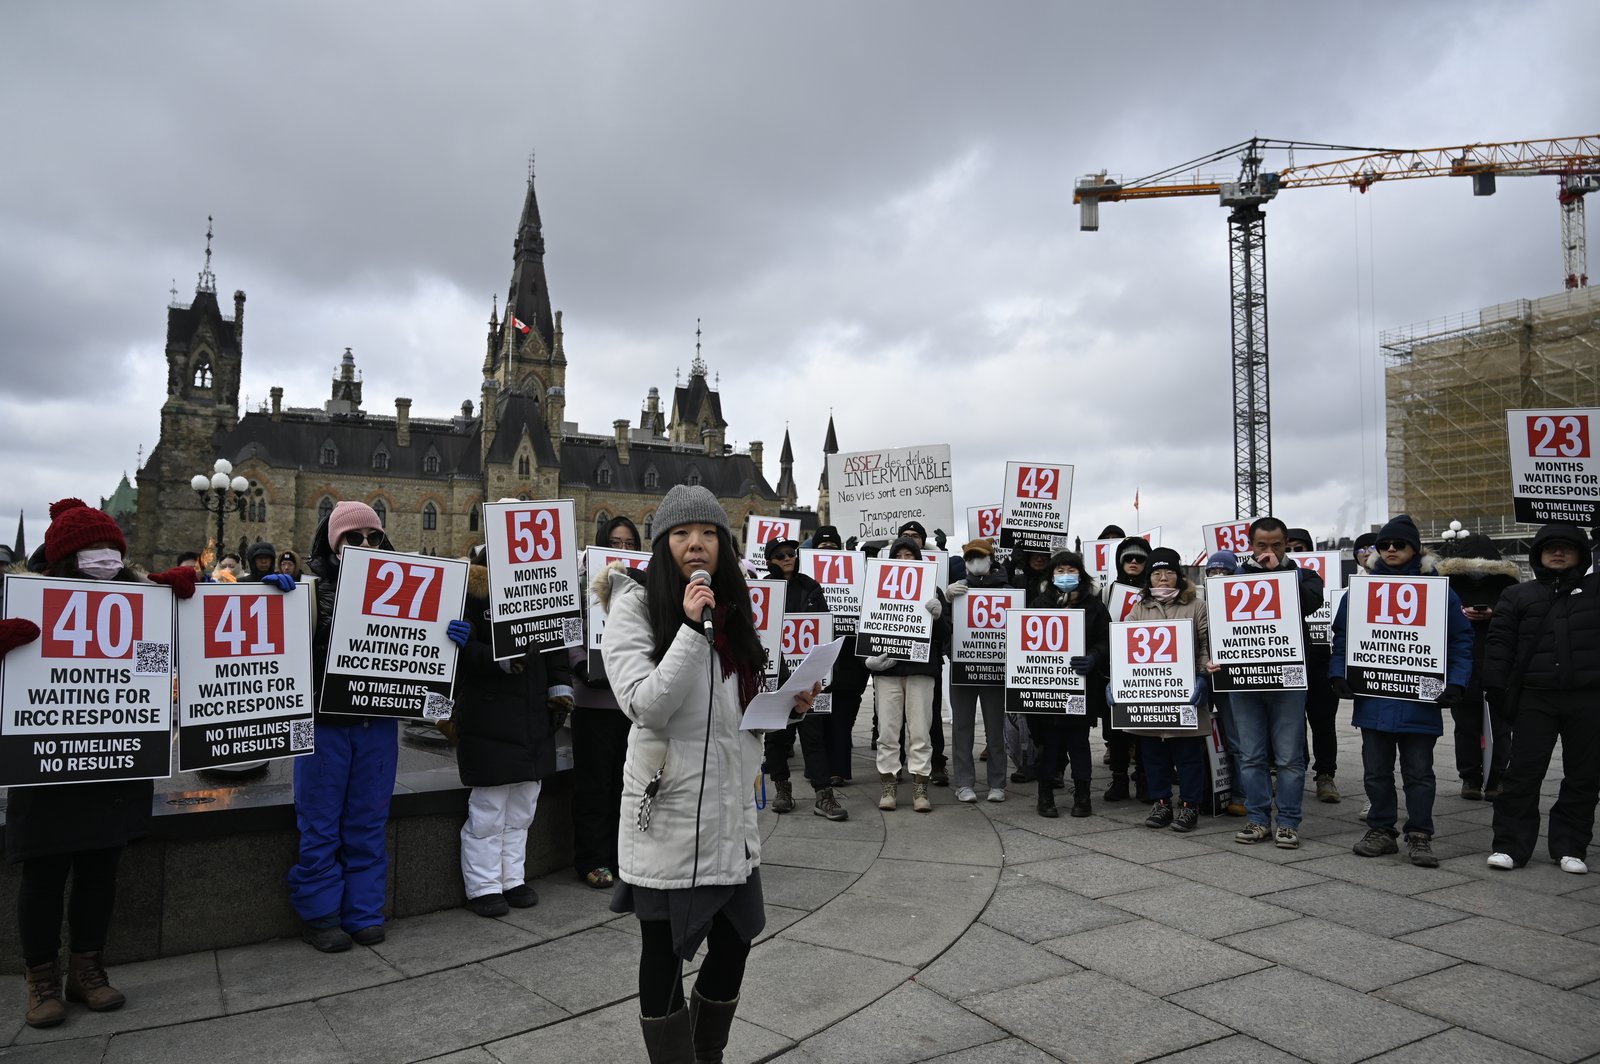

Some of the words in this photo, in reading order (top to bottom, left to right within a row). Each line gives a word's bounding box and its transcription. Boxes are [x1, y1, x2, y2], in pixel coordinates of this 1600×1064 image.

[1534, 417, 1582, 456] 23
[843, 455, 882, 473] ASSEZ
[885, 452, 902, 468] des
[905, 451, 934, 466] délais
[1535, 462, 1584, 471] MONTHS
[845, 462, 951, 487] INTERMINABLE
[1524, 473, 1571, 483] WAITING
[1575, 475, 1598, 484] FOR
[1022, 469, 1055, 499] 42
[1519, 485, 1543, 493] IRCC
[838, 491, 854, 503] Nos
[857, 490, 875, 501] vies
[877, 487, 897, 499] sont
[900, 486, 912, 496] en
[1020, 501, 1052, 510] MONTHS
[1532, 502, 1544, 510] NO
[1546, 503, 1595, 512] TIMELINES
[1011, 510, 1042, 519] WAITING
[1551, 512, 1591, 522] RESULTS
[860, 523, 887, 538] Délais
[1006, 518, 1022, 527] IRCC
[1024, 519, 1063, 529] RESPONSE
[514, 510, 556, 562] 53
[1023, 532, 1050, 540] TIMELINE
[1219, 526, 1249, 552] 35
[1101, 545, 1110, 570] 1
[514, 567, 557, 582] MONTHS
[819, 556, 848, 583] 71
[371, 562, 435, 619] 27
[504, 582, 547, 599] WAITING
[549, 580, 568, 593] FOR
[882, 567, 918, 600] 40
[499, 602, 522, 616] IRCC
[523, 595, 574, 612] RESPONSE
[1230, 581, 1274, 620] 22
[1375, 584, 1418, 624] 19
[749, 588, 763, 629] 8
[880, 603, 914, 613] MONTHS
[973, 595, 1005, 628] 65
[53, 591, 133, 657] 40
[214, 596, 274, 654] 41
[870, 612, 904, 623] WAITING
[905, 614, 922, 624] FOR
[366, 624, 426, 640] MONTHS
[511, 624, 523, 635] NO
[864, 622, 882, 631] IRCC
[883, 623, 926, 634] RESPONSE
[1026, 616, 1063, 651] 90
[1232, 625, 1276, 636] MONTHS
[515, 636, 527, 647] NO
[782, 620, 814, 653] 36
[971, 632, 1005, 640] MONTHS
[1223, 637, 1265, 648] WAITING
[1268, 636, 1289, 646] FOR
[1372, 630, 1418, 641] MONTHS
[349, 639, 409, 656] WAITING
[412, 644, 439, 658] FOR
[872, 645, 882, 653] NO
[884, 646, 912, 655] RESULTS
[963, 641, 996, 650] WAITING
[1133, 627, 1172, 663] 32
[1360, 641, 1405, 653] WAITING
[1409, 644, 1431, 655] FOR
[957, 651, 975, 660] IRCC
[976, 651, 1006, 660] RESPO
[1026, 655, 1064, 664] MONTHS
[1217, 650, 1239, 660] IRCC
[1241, 648, 1296, 659] RESPONSE
[1353, 652, 1376, 664] IRCC
[1378, 654, 1438, 668] RESPONSE
[216, 661, 279, 678] MONTHS
[337, 655, 370, 669] IRCC
[371, 657, 446, 675] RESPONSE
[1017, 666, 1053, 675] WAITING
[1056, 666, 1074, 674] FOR
[1132, 667, 1172, 676] MONTHS
[1242, 666, 1282, 674] TIMELINE
[50, 668, 131, 684] MONTHS
[1011, 676, 1031, 684] IRCC
[1032, 676, 1079, 686] RESPONSE
[1122, 678, 1160, 688] WAITING
[1164, 678, 1183, 686] FOR
[1233, 676, 1246, 684] NO
[1247, 676, 1283, 684] RESULTS
[1363, 671, 1376, 679] NO
[1377, 671, 1420, 683] TIMELINE
[199, 681, 262, 698] WAITING
[267, 678, 295, 692] FOR
[348, 681, 365, 692] NO
[1367, 681, 1379, 689] NO
[28, 688, 110, 704] WAITING
[115, 689, 150, 703] FOR
[1117, 690, 1138, 699] IRCC
[1139, 689, 1189, 698] RESPONSE
[190, 702, 224, 718] IRCC
[227, 694, 303, 715] RESPONSE
[352, 695, 368, 706] NO
[371, 696, 421, 709] RESULTS
[1036, 701, 1066, 709] RESULTS
[1140, 705, 1180, 713] TIMELINES
[14, 710, 58, 726] IRCC
[62, 708, 160, 725] RESPONSE
[1143, 714, 1177, 722] RESULTS
[206, 729, 223, 742] NO
[226, 722, 290, 740] TIMELINES
[34, 741, 56, 754] NO
[60, 739, 141, 754] TIMELINES
[212, 744, 229, 756] NO
[232, 737, 285, 754] RESULTS
[40, 759, 63, 772] NO
[67, 756, 134, 770] RESULTS
